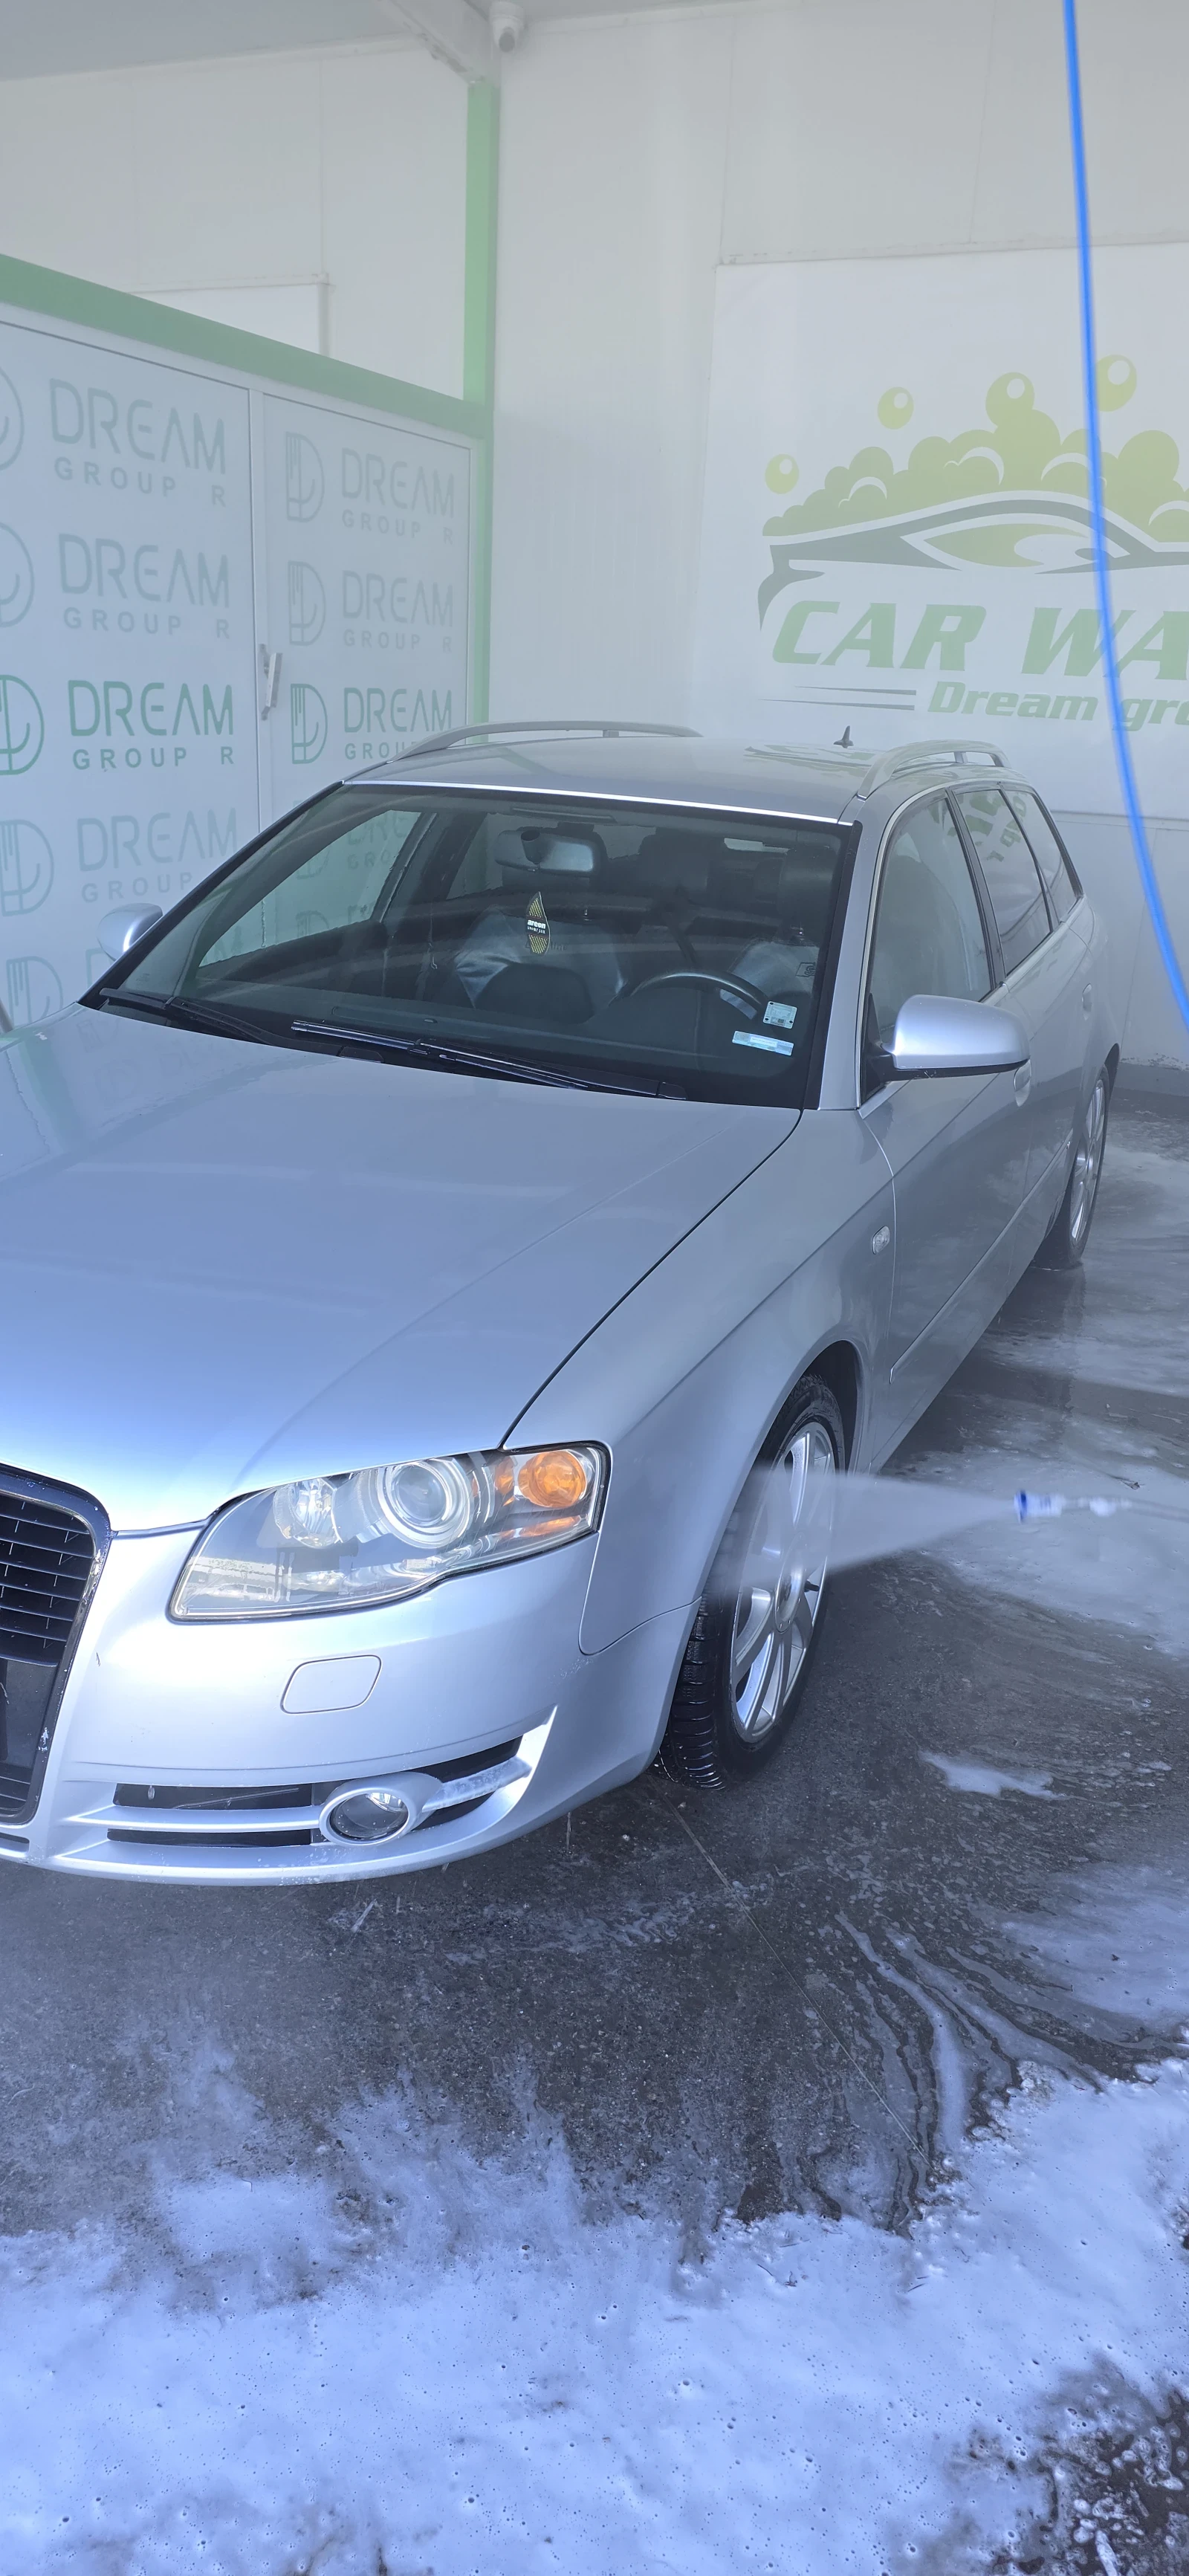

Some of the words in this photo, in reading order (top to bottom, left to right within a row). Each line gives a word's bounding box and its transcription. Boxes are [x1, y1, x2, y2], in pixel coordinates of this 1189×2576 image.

[49, 377, 226, 474] DREAM
[54, 456, 176, 496] GROUP
[211, 485, 226, 507] R
[341, 447, 454, 519] DREAM
[341, 509, 421, 538] GROUP
[443, 526, 453, 545] R
[58, 533, 230, 608] DREAM
[62, 606, 181, 635] GROUP
[216, 619, 230, 639] R
[342, 570, 453, 627] DREAM
[343, 628, 421, 650] GROUP
[442, 636, 452, 653] R
[771, 600, 987, 672] CAR
[1021, 606, 1189, 680] WA
[67, 679, 233, 737] DREAM
[343, 687, 452, 733] DREAM
[927, 681, 1098, 721] Dream
[72, 747, 187, 770] GROUP
[221, 745, 233, 765] R
[77, 807, 238, 872] DREAM
[81, 871, 193, 903] GROUP
[528, 919, 546, 929] areon
